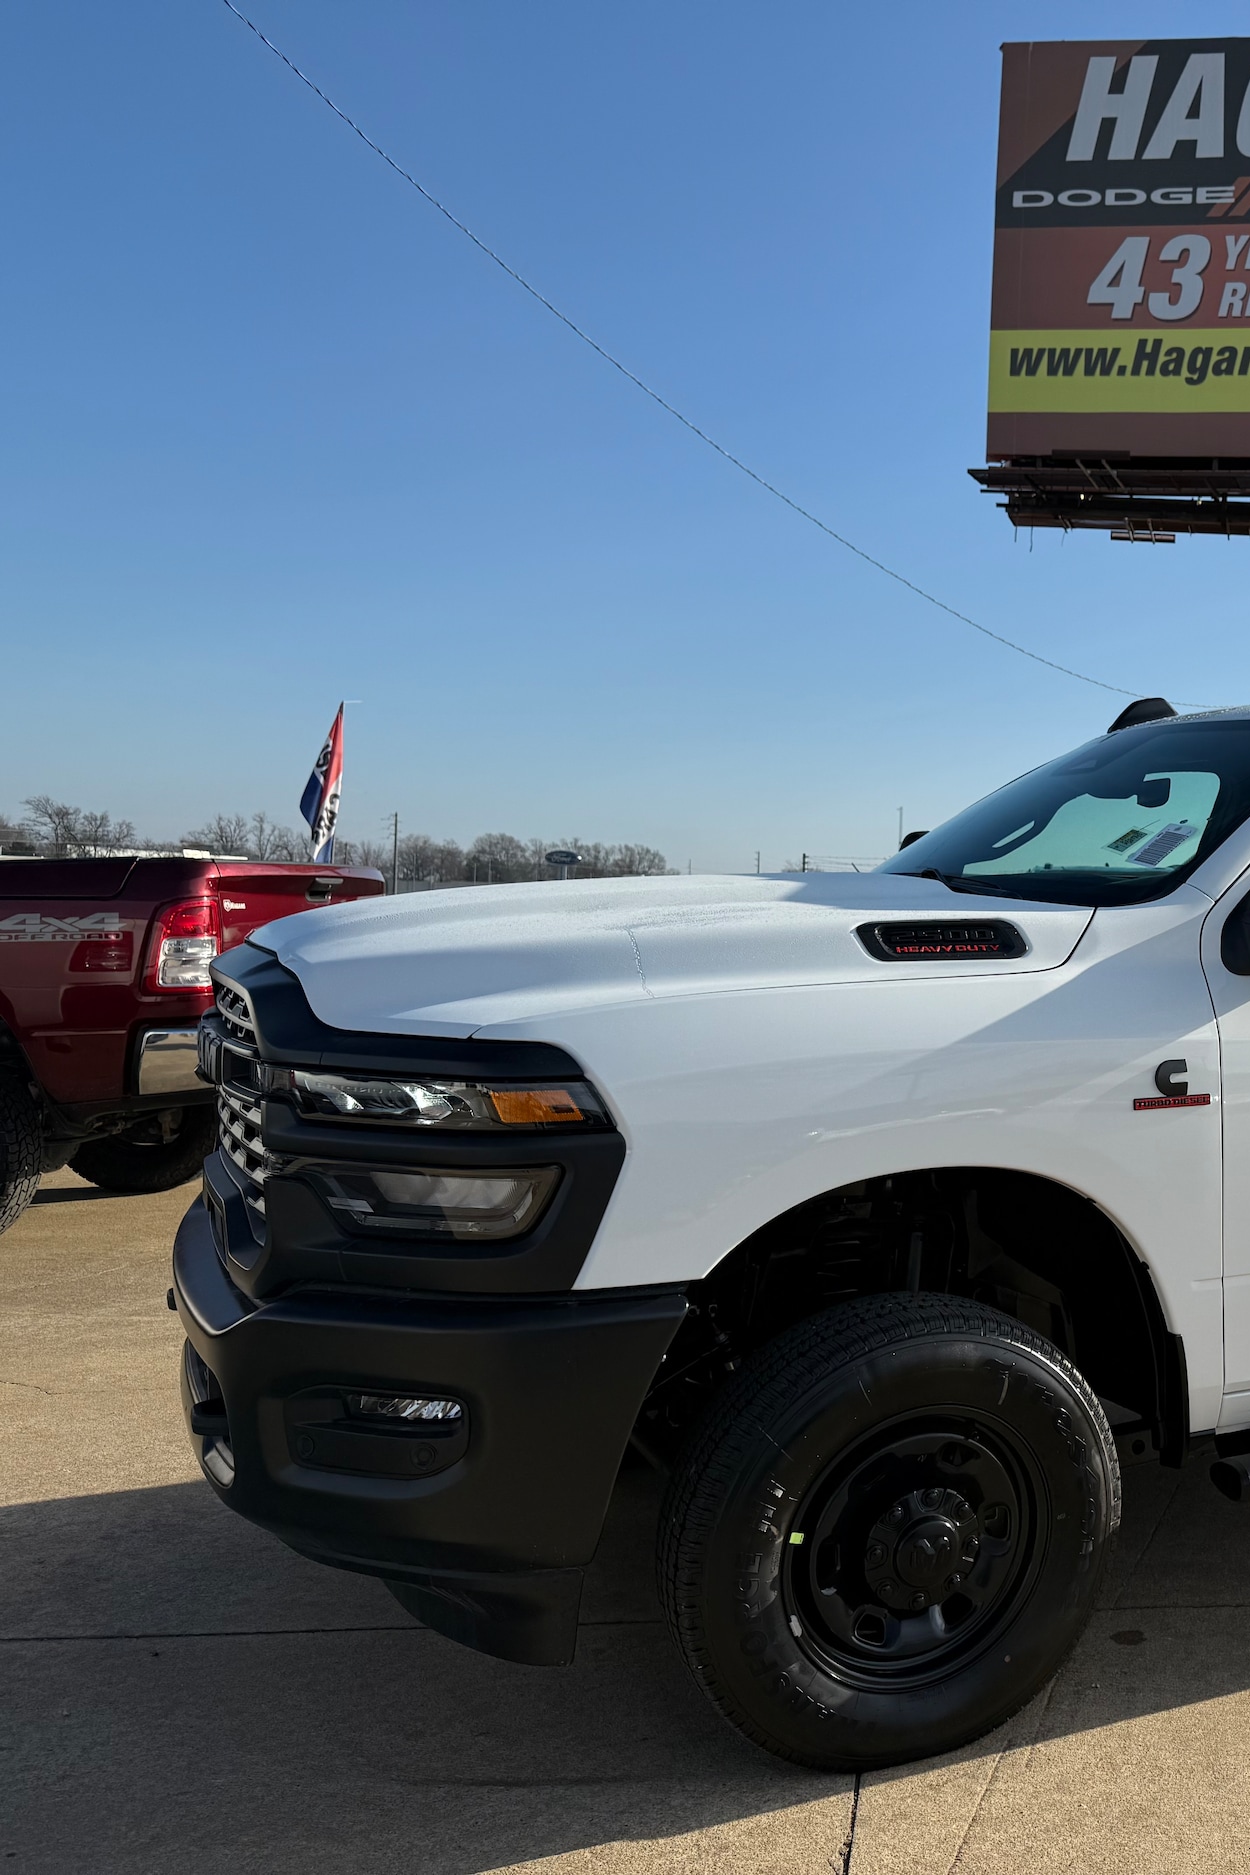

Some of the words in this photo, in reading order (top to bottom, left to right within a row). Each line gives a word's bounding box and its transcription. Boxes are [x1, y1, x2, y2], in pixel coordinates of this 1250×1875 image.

[1012, 186, 1235, 208] DODGE
[1086, 234, 1212, 321] 43
[0, 912, 127, 932] 4x4
[0, 933, 46, 941] OFF
[51, 933, 120, 941] ROAD
[889, 929, 995, 942] 2500
[896, 945, 952, 953] HEAVY
[955, 944, 1000, 952] DUTY
[1136, 1099, 1171, 1108] TURBO
[1173, 1096, 1209, 1106] DIESEL
